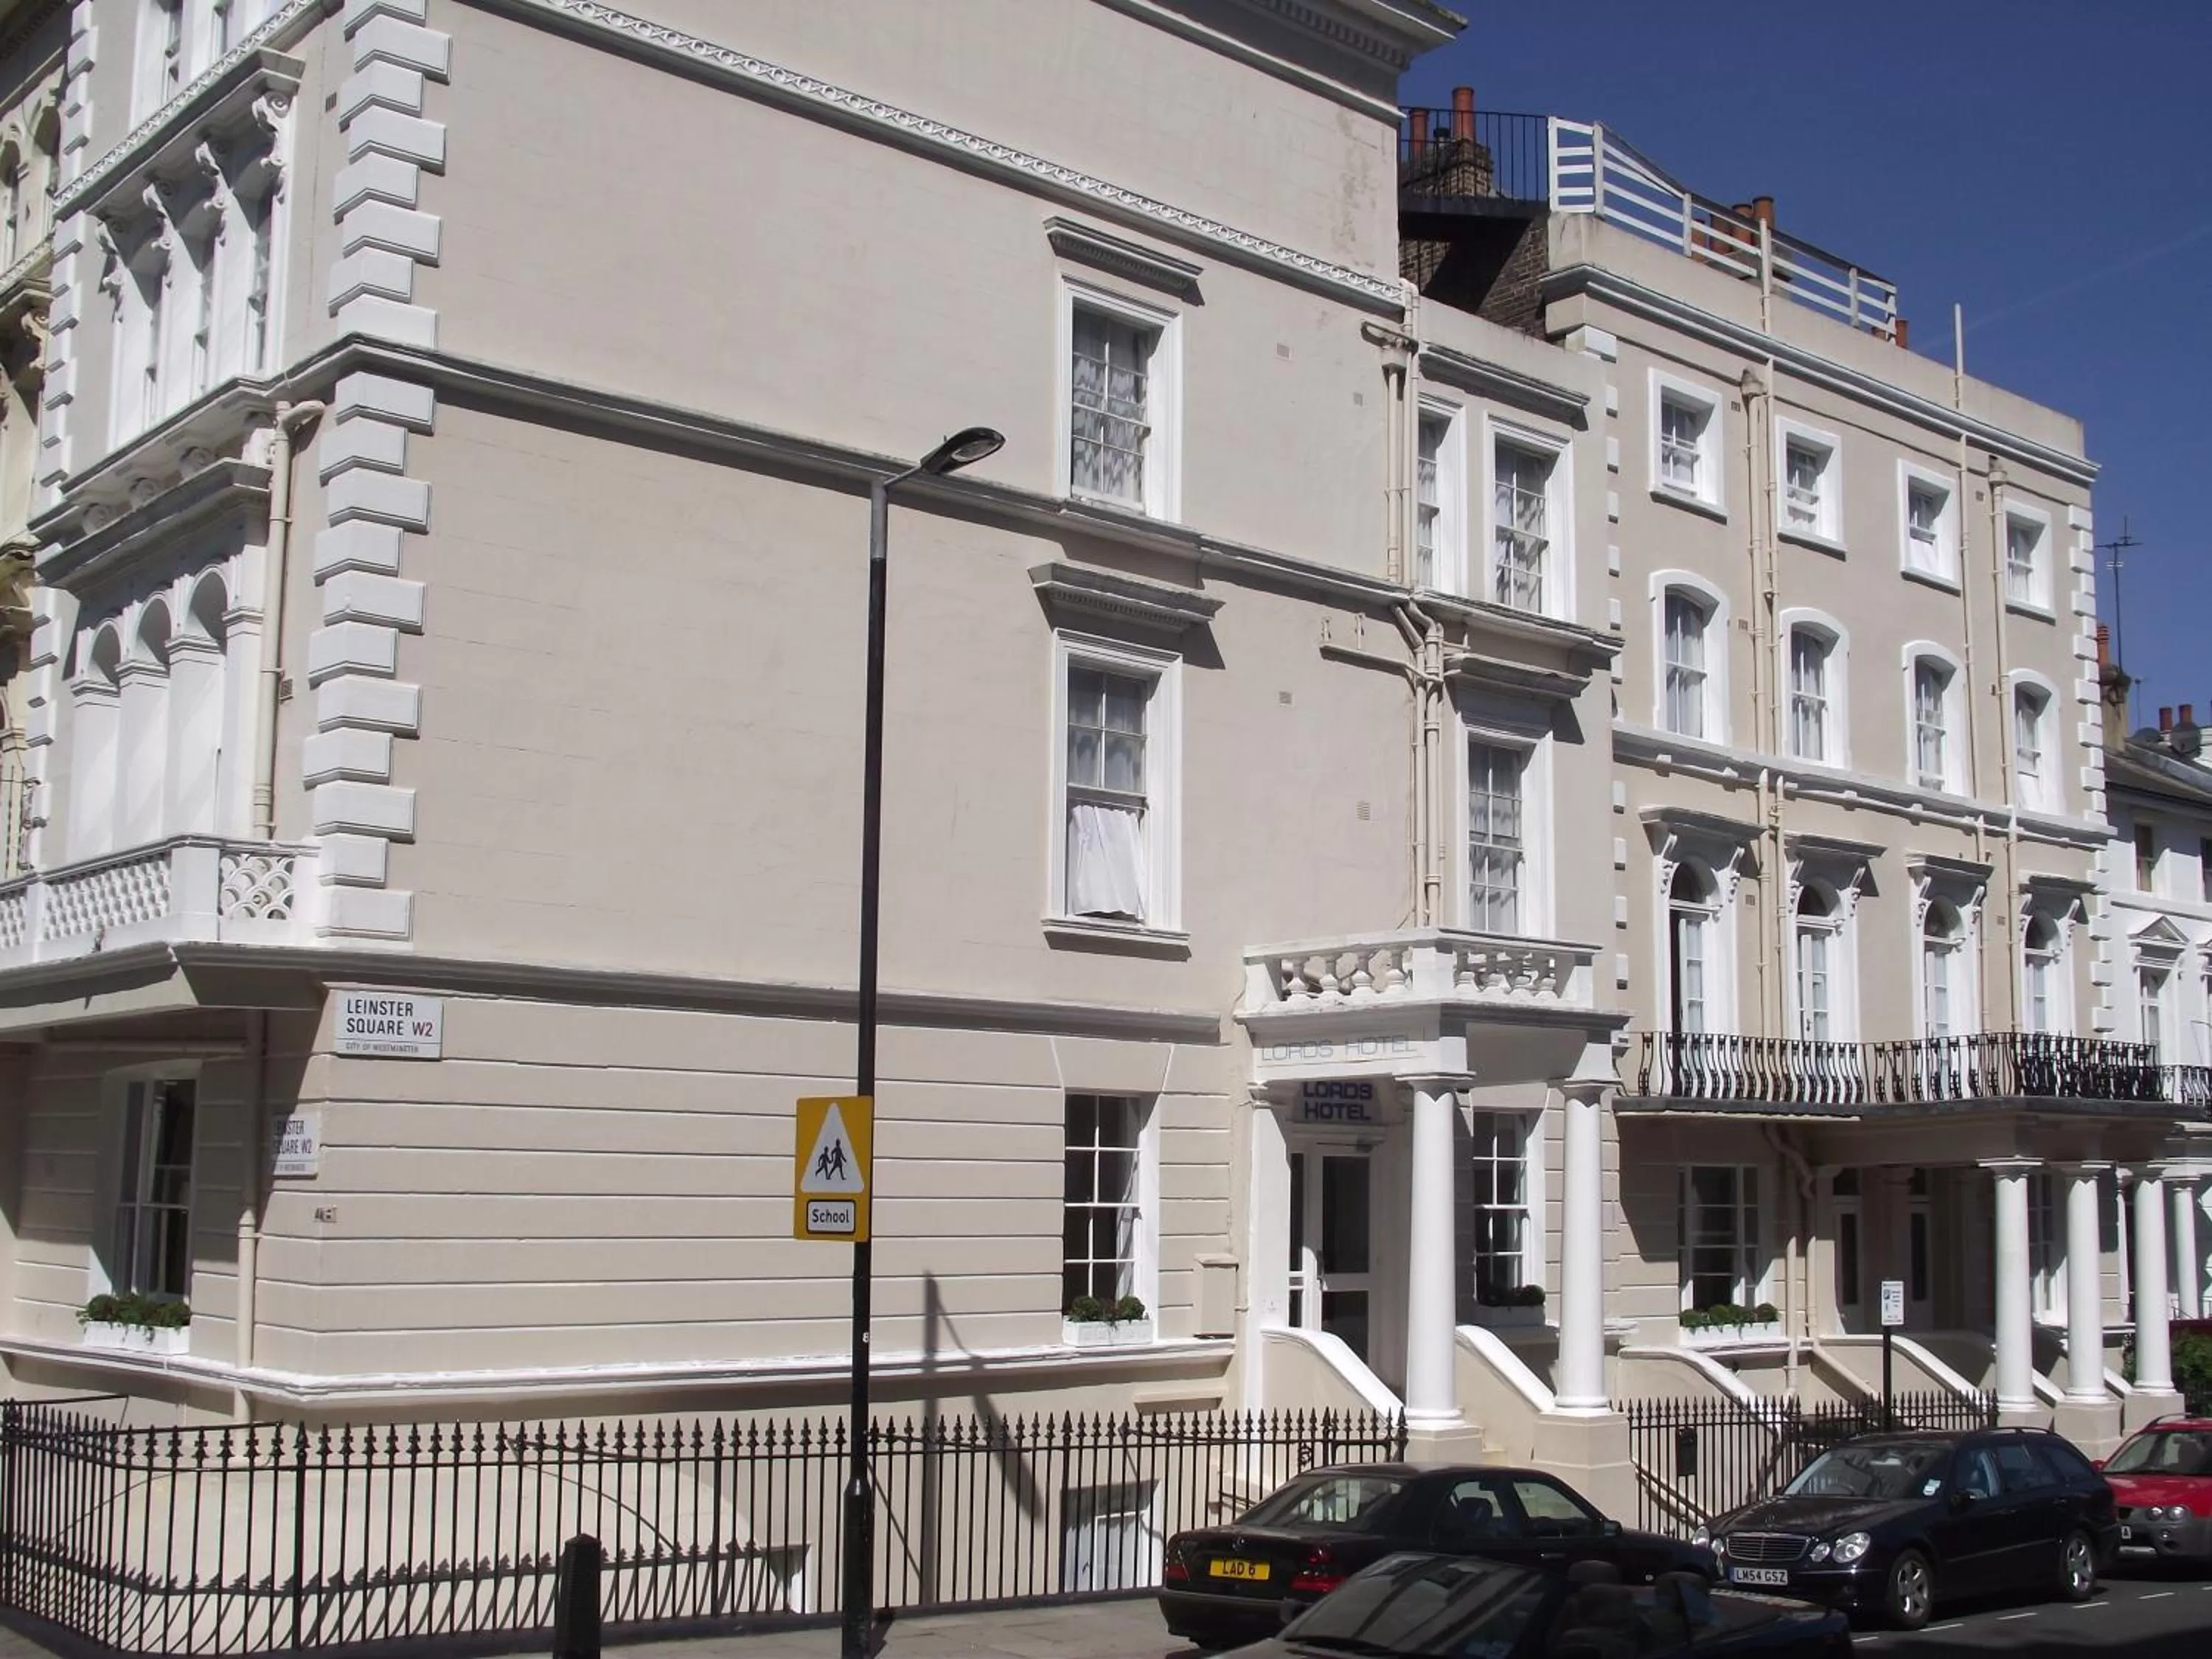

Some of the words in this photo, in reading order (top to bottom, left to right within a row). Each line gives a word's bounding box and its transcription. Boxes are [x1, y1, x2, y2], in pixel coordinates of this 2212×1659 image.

[347, 998, 414, 1017] LEINSTER
[346, 1018, 404, 1036] SQUARE
[412, 1021, 433, 1037] W2
[345, 1042, 360, 1050] CITY
[1262, 1040, 1334, 1061] LORDS
[1344, 1034, 1416, 1055] HOTEL
[1303, 1080, 1373, 1099] LORDS
[1304, 1101, 1372, 1121] HOTEL
[812, 1208, 849, 1224] School
[1222, 1560, 1244, 1575] LAD
[1248, 1562, 1256, 1575] 6
